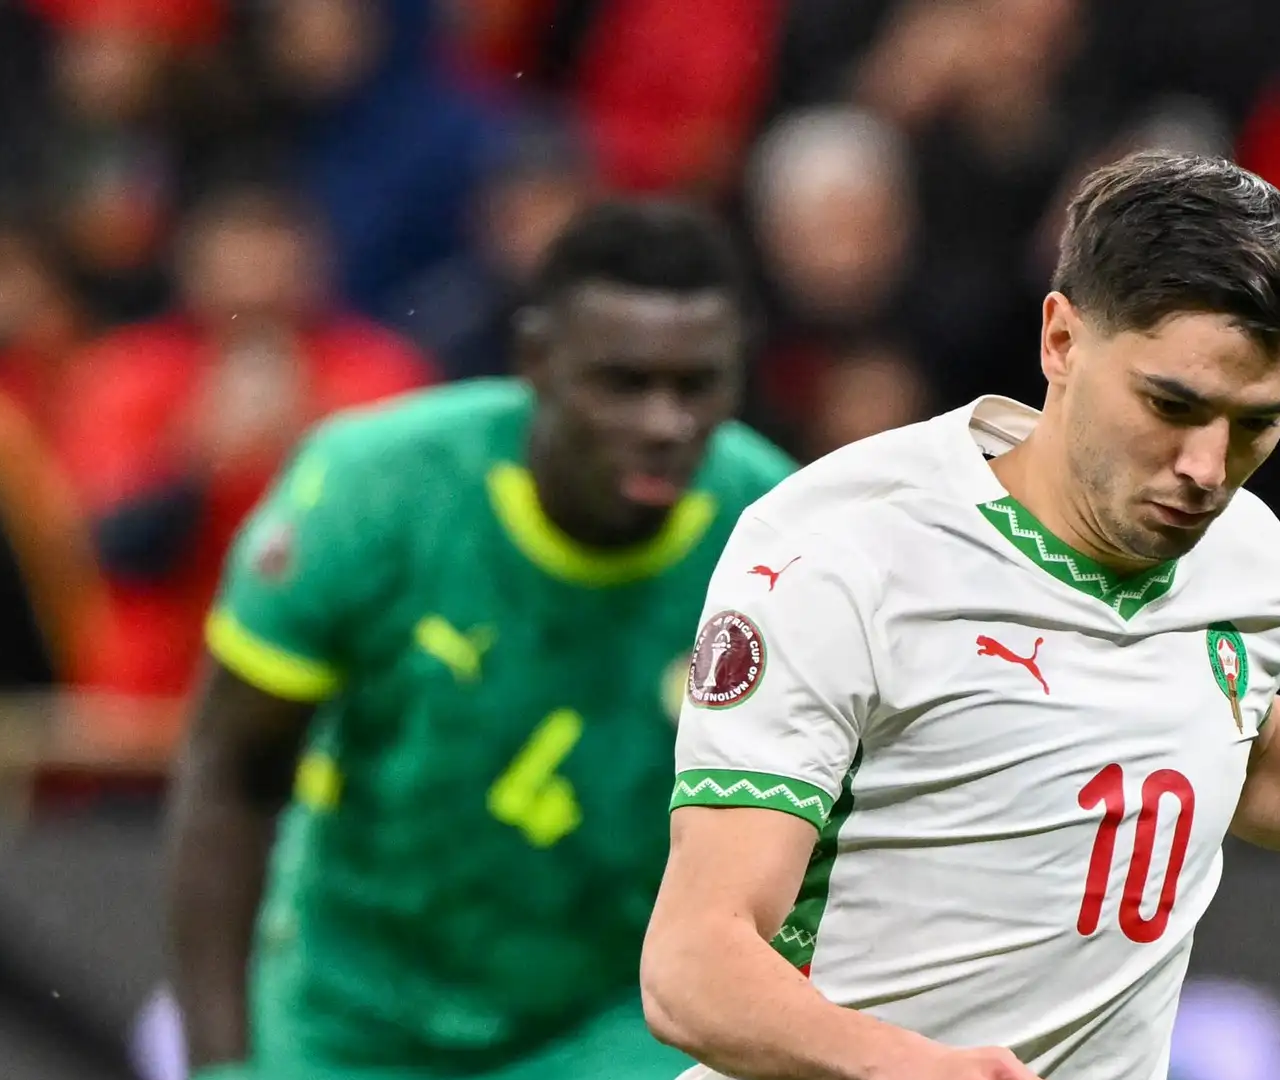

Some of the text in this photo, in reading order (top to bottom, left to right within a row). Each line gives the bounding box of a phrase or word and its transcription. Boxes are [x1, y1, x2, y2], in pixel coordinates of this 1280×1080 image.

[749, 640, 761, 664] CUP
[747, 666, 758, 682] OF
[703, 680, 749, 702] NATIONS
[487, 710, 582, 848] 4
[1077, 762, 1196, 944] 10
